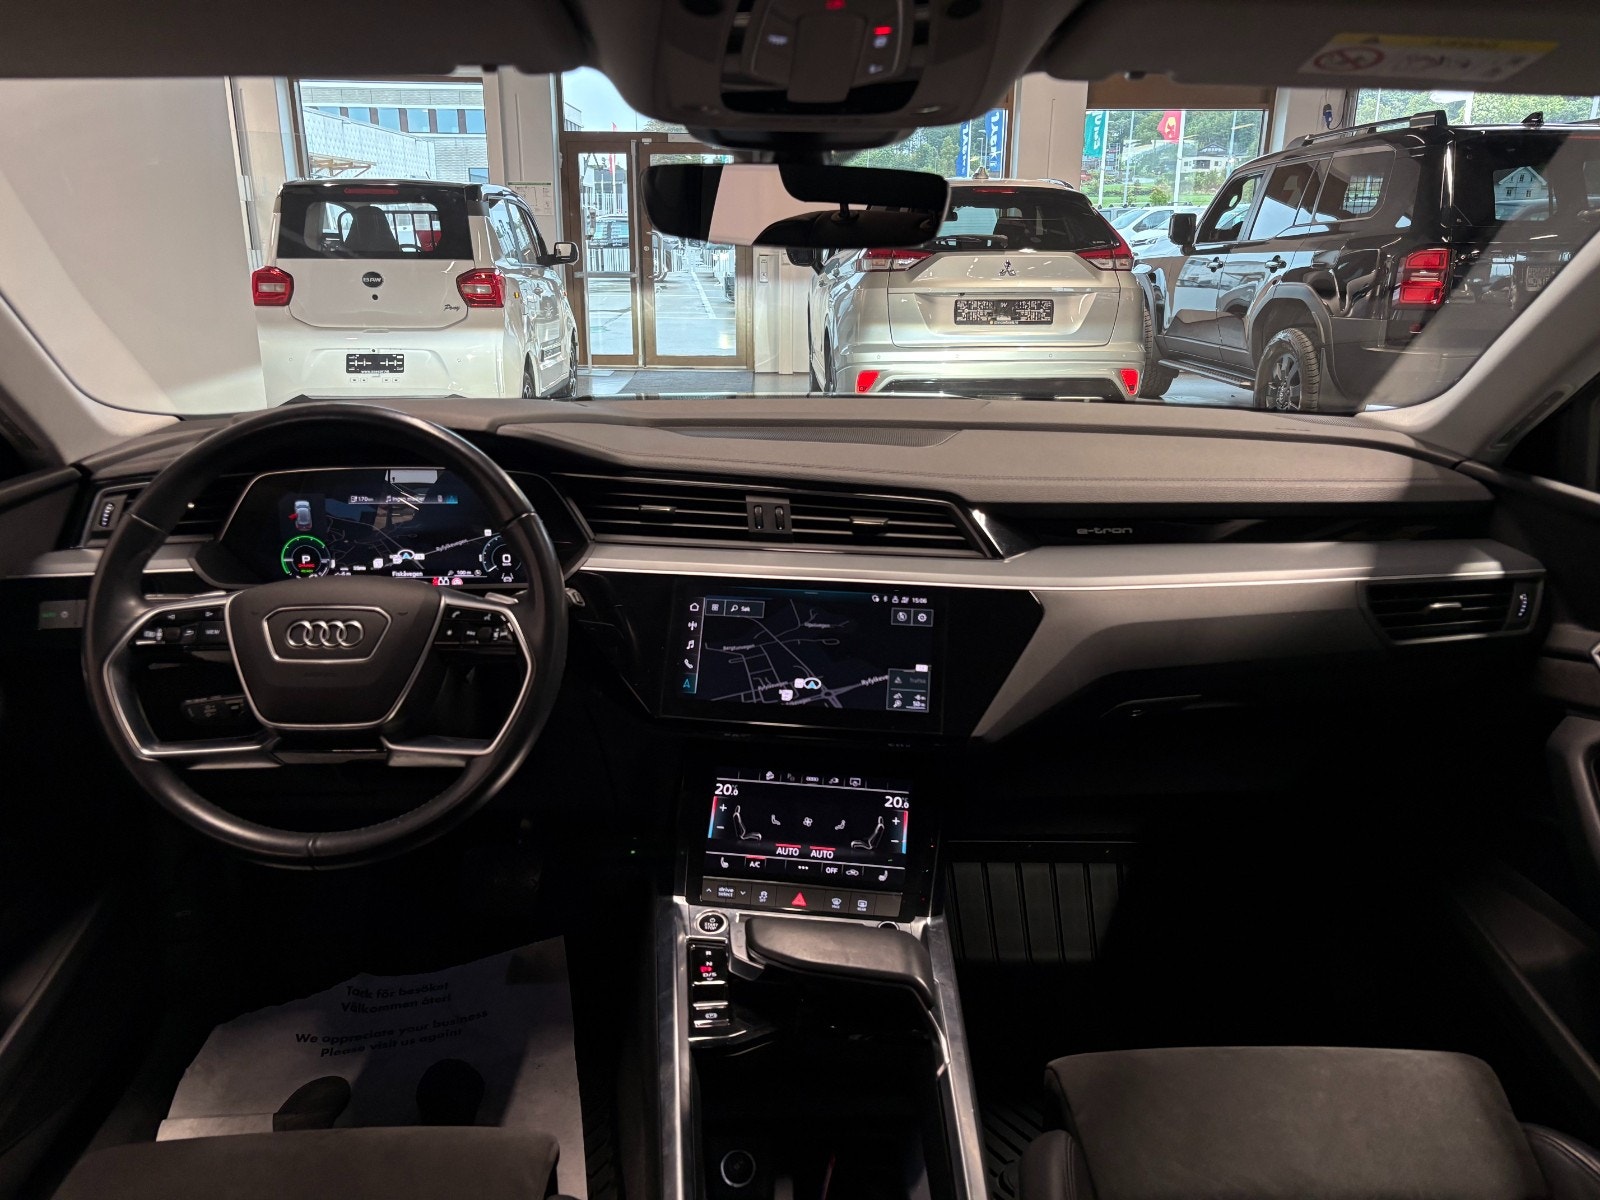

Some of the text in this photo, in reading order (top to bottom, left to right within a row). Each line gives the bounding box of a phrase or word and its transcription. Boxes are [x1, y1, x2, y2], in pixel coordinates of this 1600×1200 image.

[443, 303, 460, 311] Pony
[1076, 527, 1134, 535] e-tron
[301, 554, 311, 564] P
[502, 554, 511, 563] 0
[776, 847, 800, 856] AUTO
[810, 850, 834, 859] AUTO
[346, 982, 449, 999] Tack för besöket!
[341, 993, 452, 1014] Välkommen åter!
[295, 1011, 488, 1045] We appreciate your business
[320, 1028, 462, 1057] Please visit us again!
